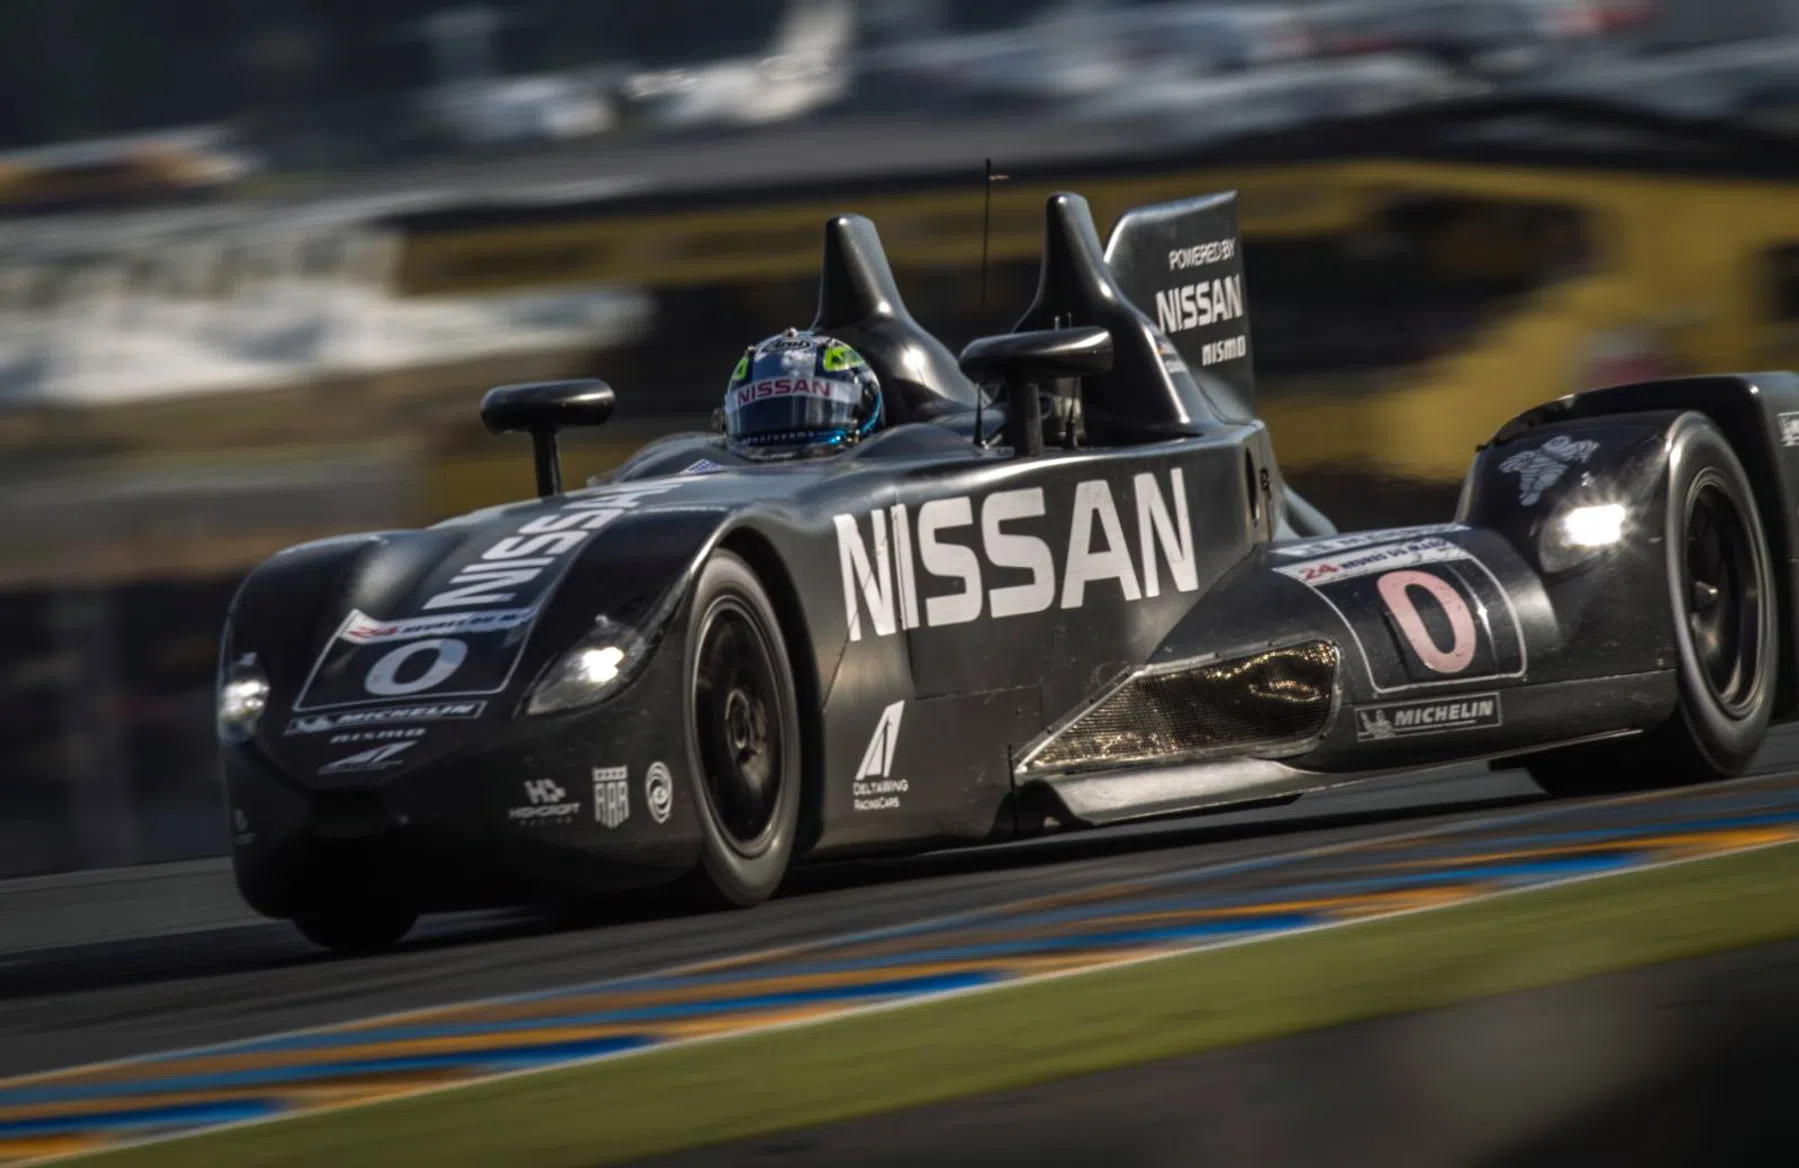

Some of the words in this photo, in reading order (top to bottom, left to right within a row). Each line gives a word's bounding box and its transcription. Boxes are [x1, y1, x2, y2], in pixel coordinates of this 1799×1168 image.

[1168, 241, 1221, 271] POWERED
[1221, 238, 1236, 261] BY
[1156, 273, 1243, 334] NISSAN
[737, 378, 831, 406] NISSAN
[833, 468, 1199, 641] NISSAN
[1300, 564, 1339, 581] 24
[1377, 570, 1477, 673] 0
[364, 638, 469, 696] 0
[336, 703, 476, 725] MICHELIN
[1394, 700, 1493, 727] MICHELIN
